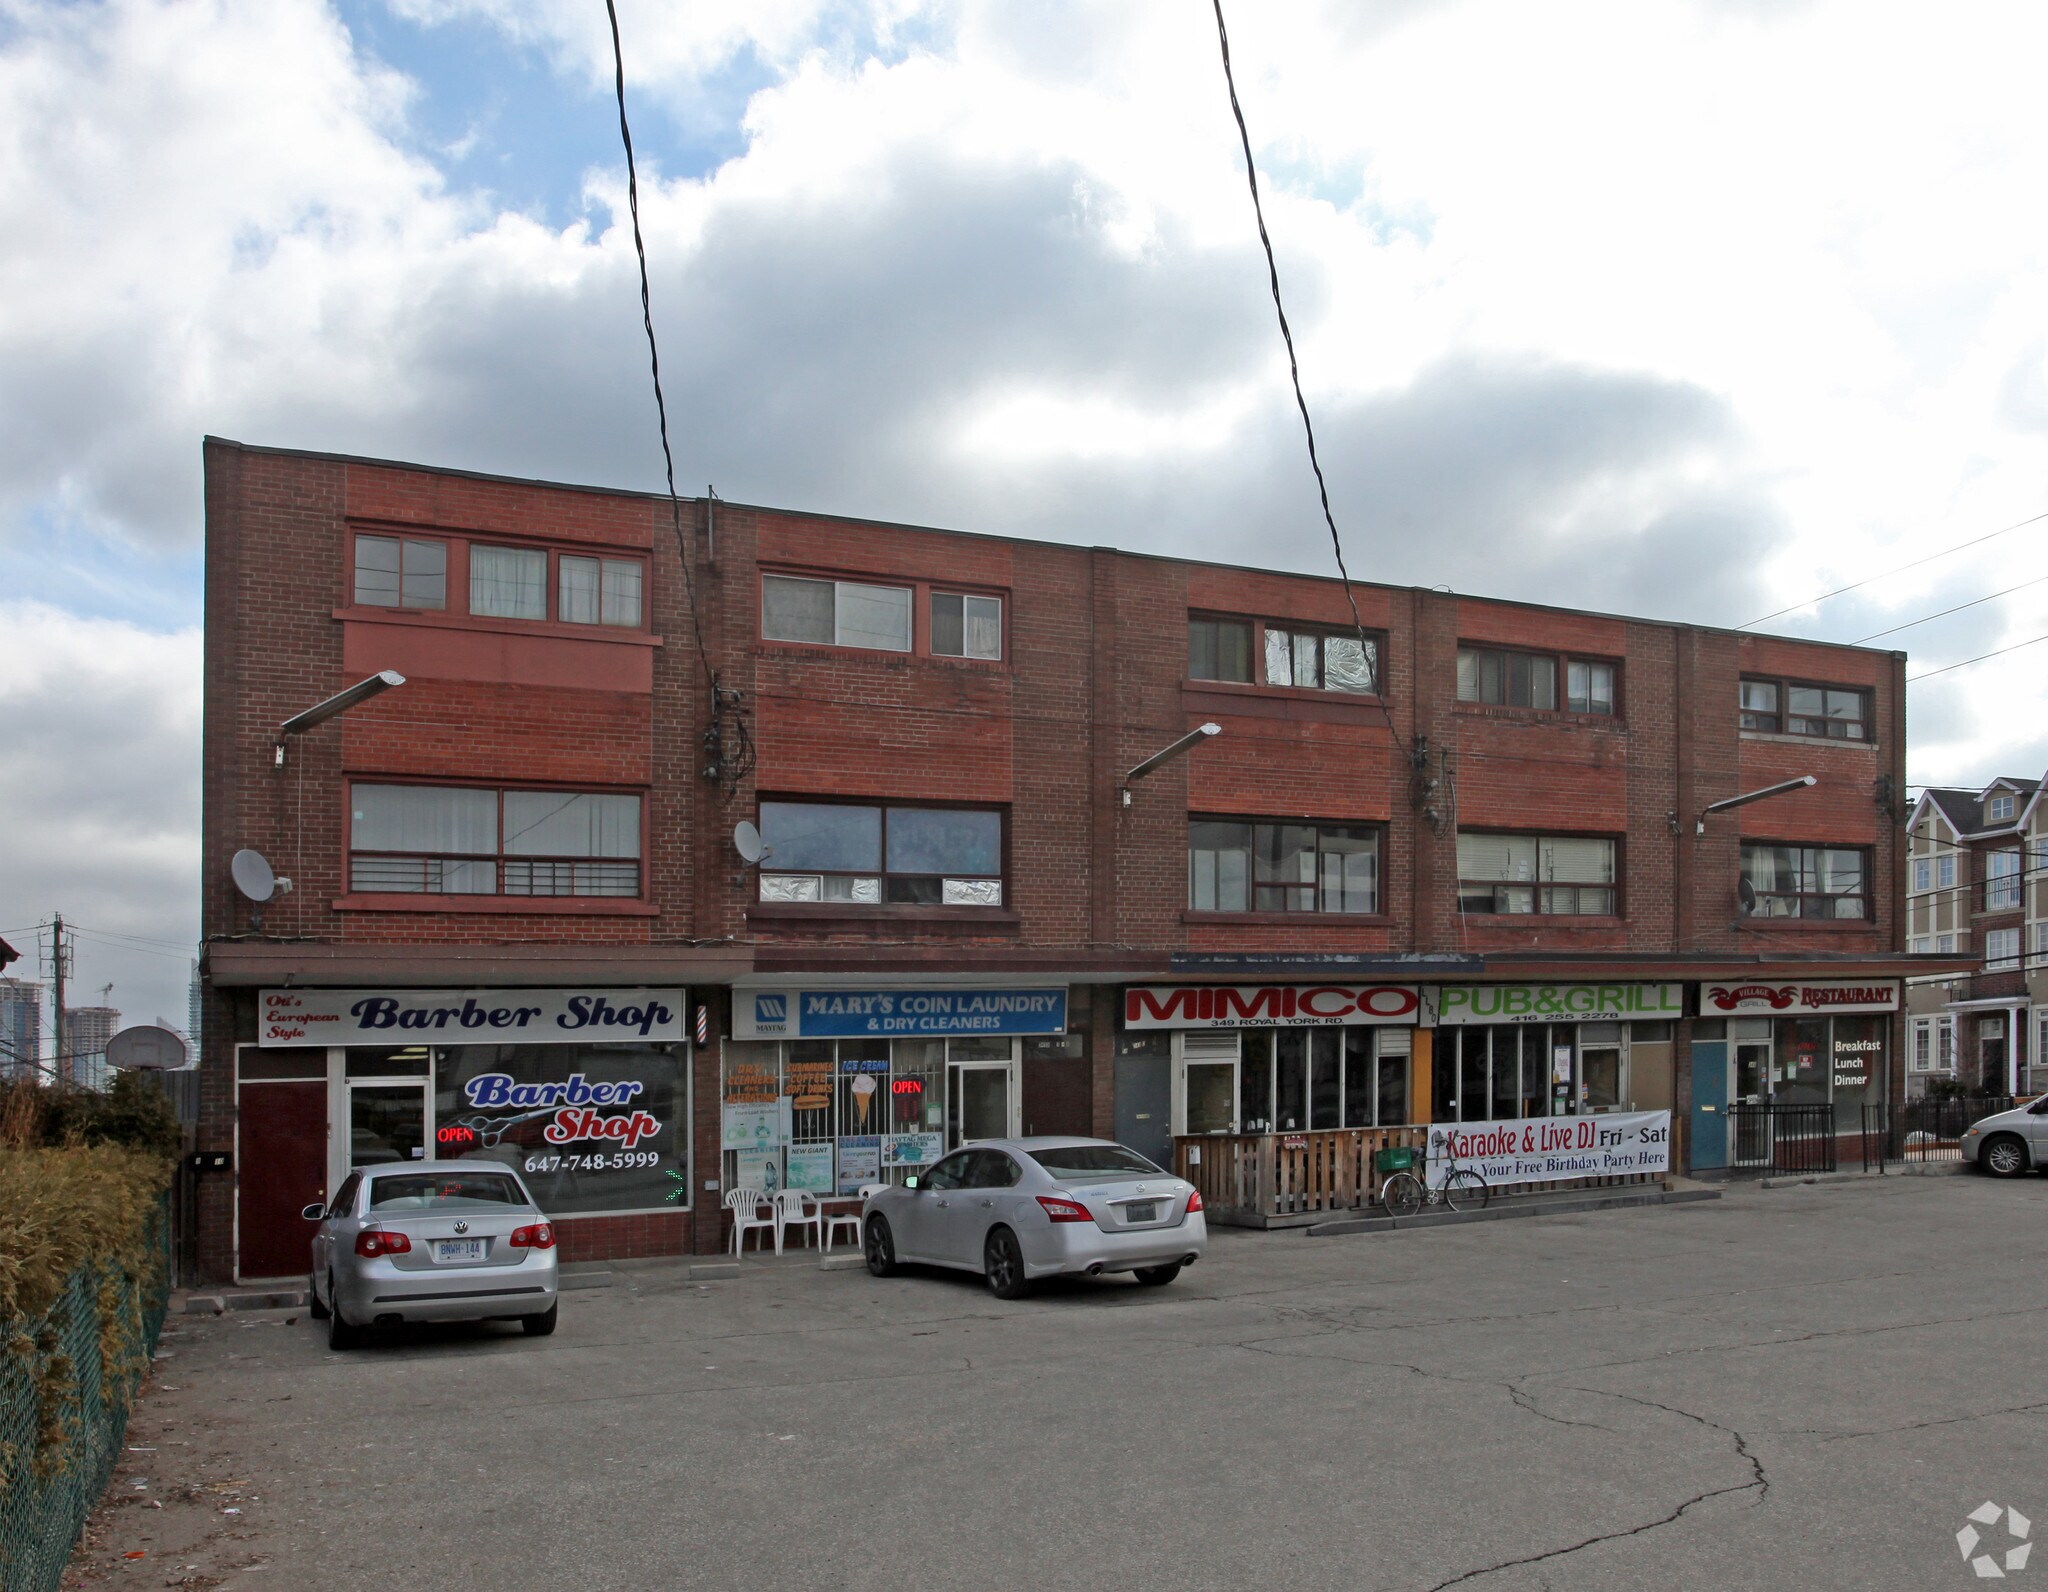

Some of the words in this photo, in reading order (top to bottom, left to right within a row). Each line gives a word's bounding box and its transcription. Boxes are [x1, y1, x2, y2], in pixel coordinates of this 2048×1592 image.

[1739, 988, 1769, 997] VILLAGE
[1800, 987, 1894, 1008] RESTAURANT
[806, 994, 893, 1014] MARY'S
[900, 997, 950, 1013] COIN
[957, 996, 1057, 1013] LAUNDRY
[1126, 987, 1418, 1021] MIMICO
[1439, 985, 1682, 1016] PUB&GRILL
[266, 1010, 340, 1025] European
[350, 998, 542, 1028] Barber
[557, 996, 674, 1035] Shop
[867, 1018, 879, 1030] &
[884, 1017, 917, 1030] DRY
[920, 1016, 1000, 1030] CLEANERS
[266, 1025, 305, 1040] Style
[1835, 1040, 1881, 1052] Breakfast
[737, 1063, 763, 1074] DRY
[785, 1062, 833, 1072] SUBMARINES
[842, 1061, 858, 1071] ICE
[861, 1060, 888, 1070] CREAM
[1835, 1057, 1863, 1069] Lunch
[727, 1075, 776, 1085] CLEANERS
[790, 1073, 826, 1083] COFFEE
[1835, 1075, 1867, 1086] Dinner
[464, 1073, 643, 1107] Barber
[785, 1084, 805, 1094] SOFT
[807, 1084, 833, 1094] DRINKS
[892, 1080, 922, 1094] OPEN
[727, 1093, 777, 1104] ALTERATIONS
[544, 1107, 662, 1149] Shop
[437, 1128, 473, 1143] OPEN
[1447, 1125, 1517, 1158] Karaoke
[1522, 1125, 1534, 1153] &
[1541, 1122, 1572, 1151] Live
[1577, 1121, 1596, 1149] DJ
[1600, 1128, 1623, 1146] Fri
[1640, 1126, 1667, 1143] Sat
[525, 1152, 659, 1172] 647-748-5999
[1481, 1162, 1512, 1177] Your
[1515, 1160, 1542, 1174] Free
[1546, 1156, 1599, 1172] Birthday
[1604, 1154, 1635, 1169] Party
[1638, 1152, 1665, 1165] Here
